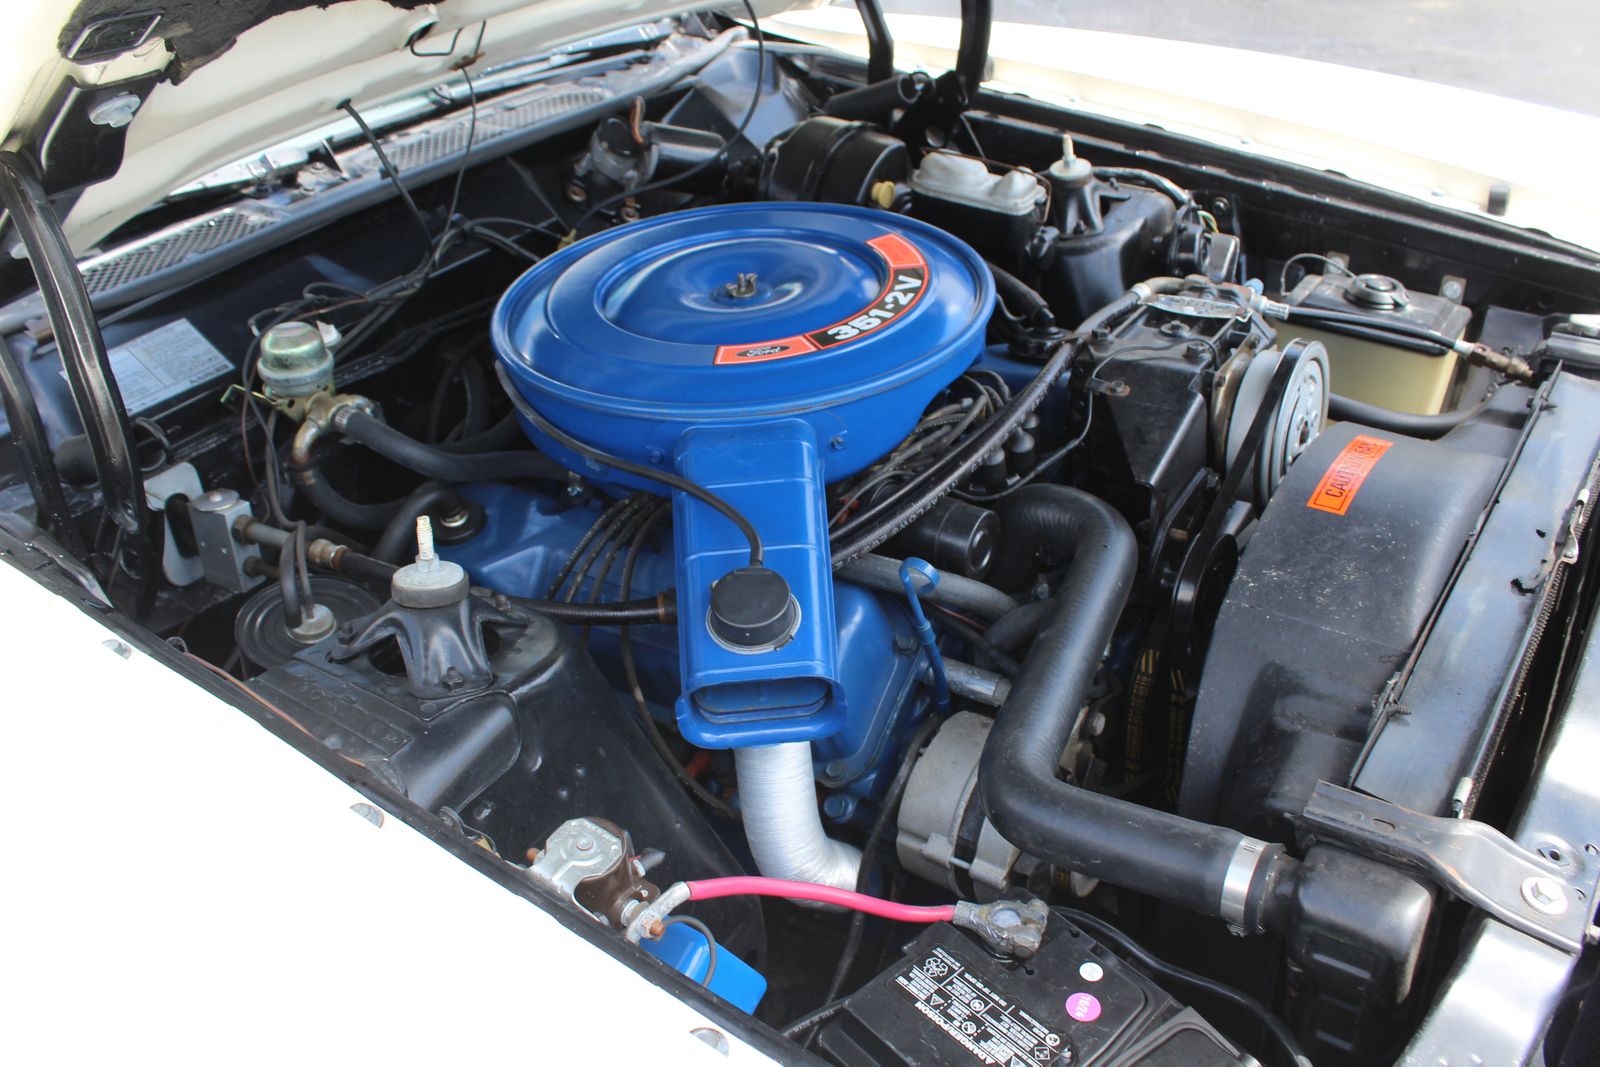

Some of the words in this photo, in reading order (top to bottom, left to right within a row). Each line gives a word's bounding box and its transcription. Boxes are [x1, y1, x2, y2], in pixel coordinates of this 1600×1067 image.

[827, 275, 922, 341] 351-2V
[745, 345, 782, 358] Ford
[915, 1001, 986, 1060] DANGER/POISON
